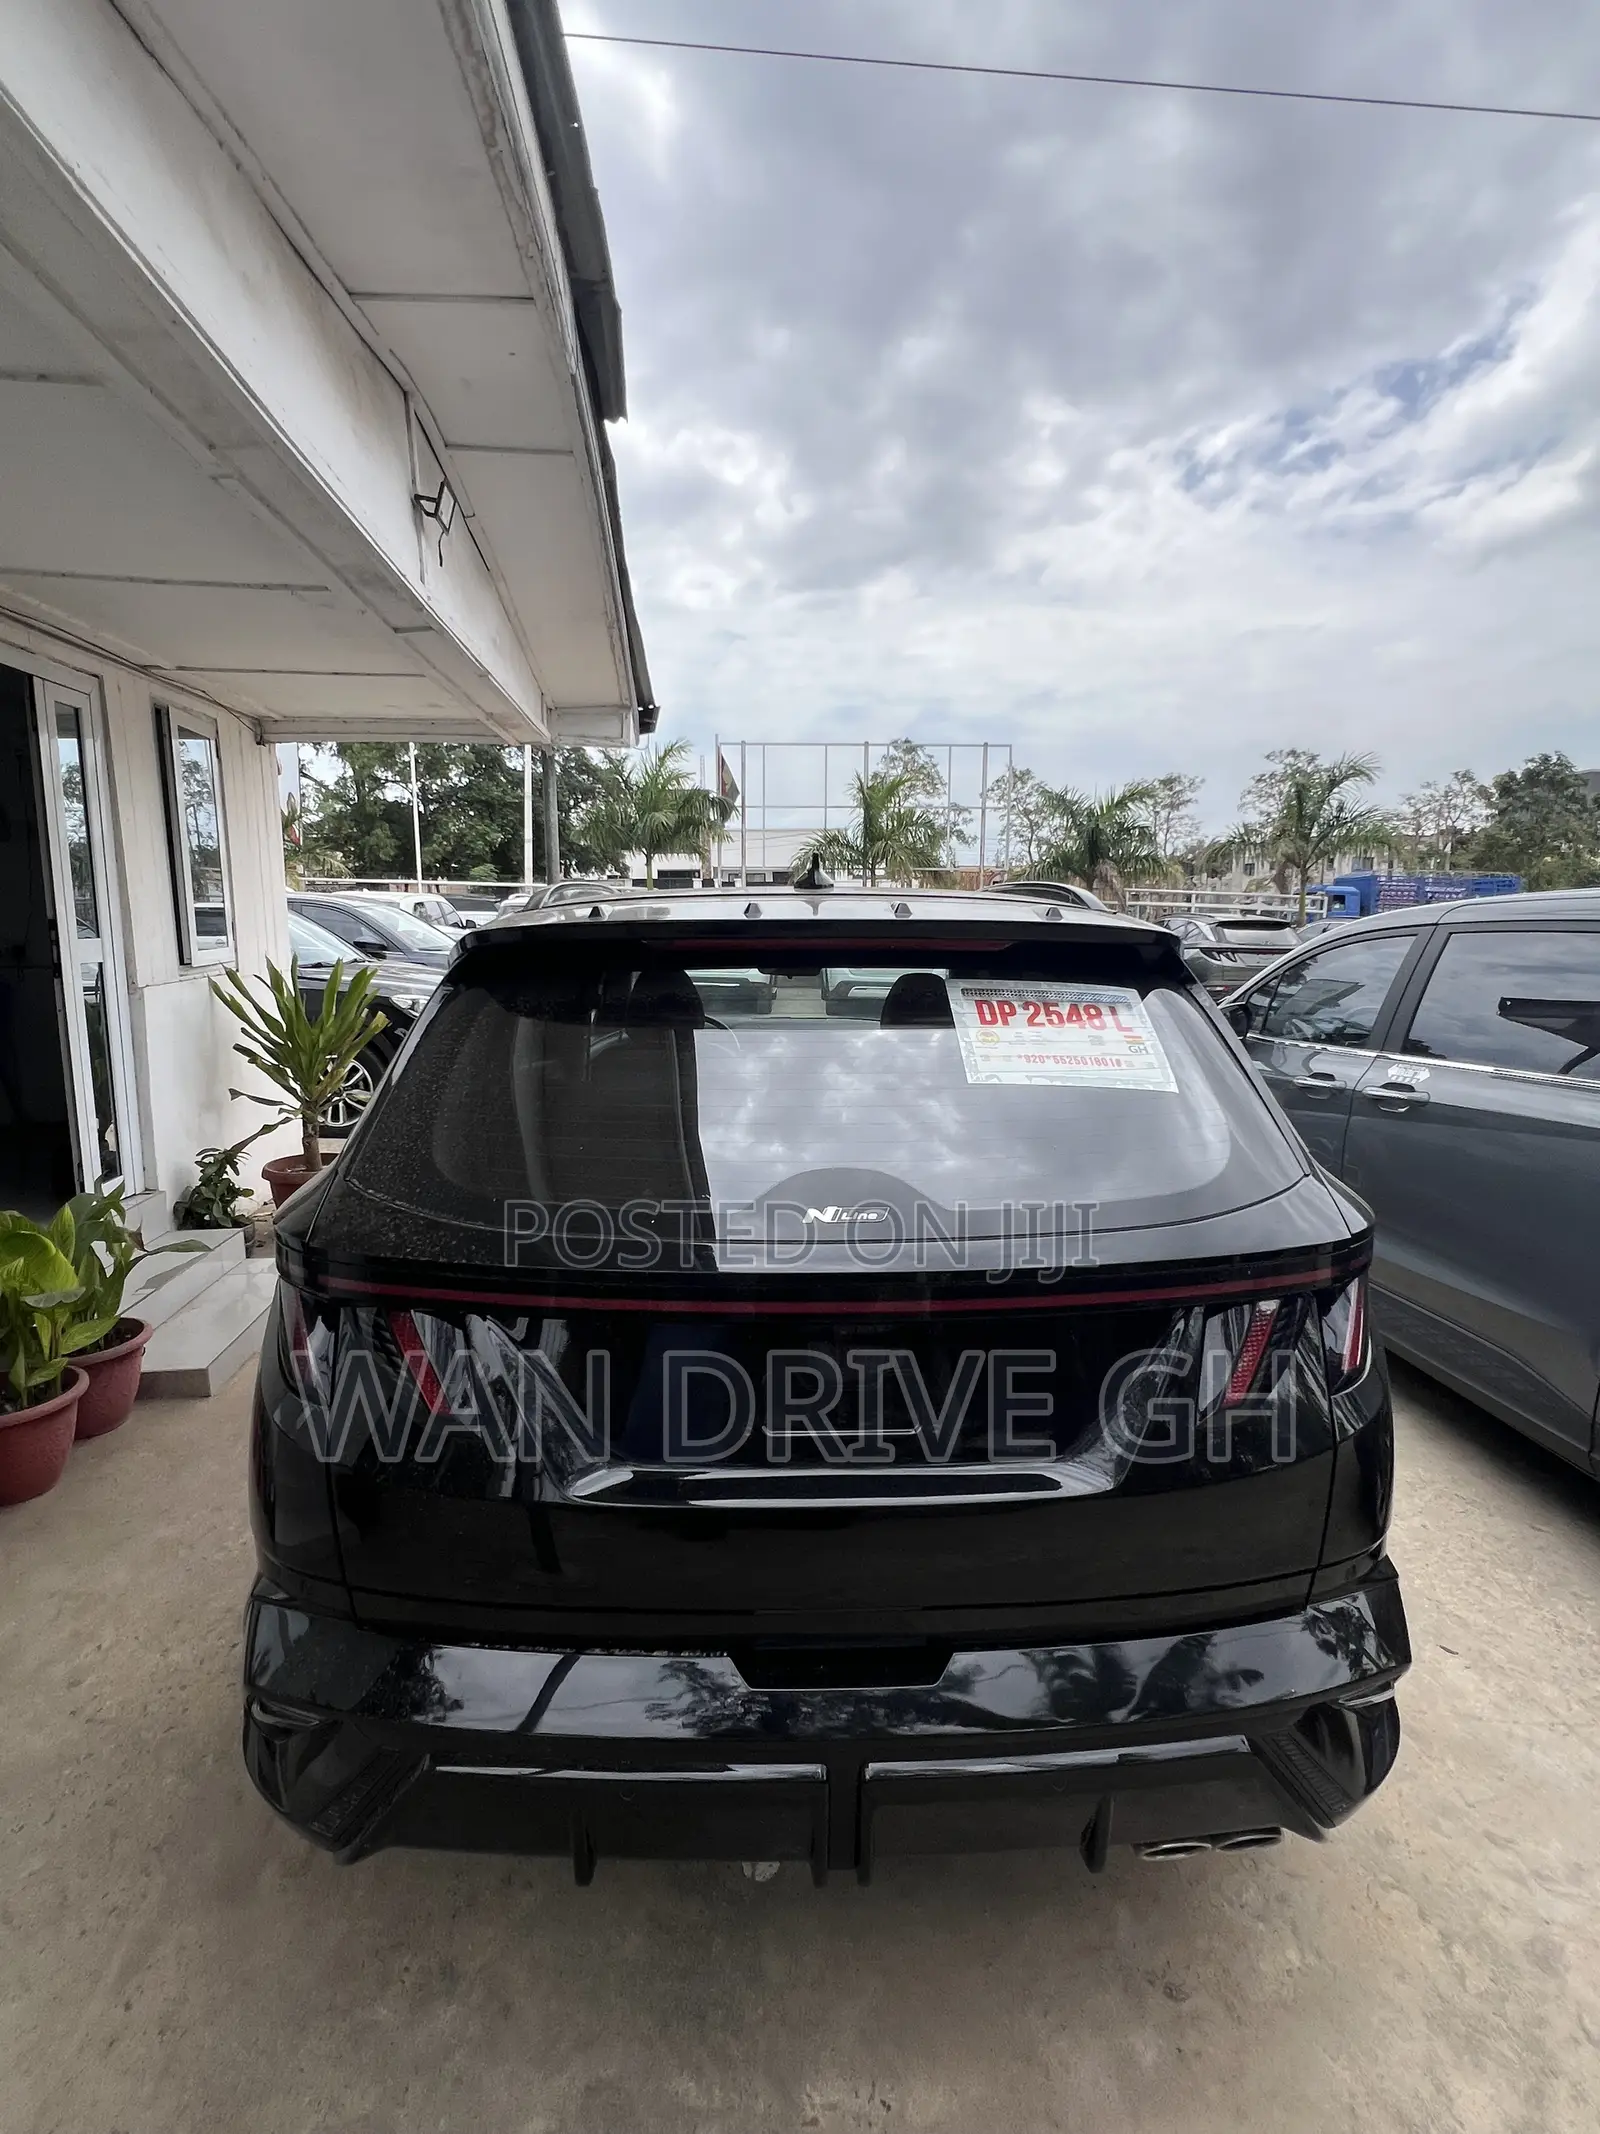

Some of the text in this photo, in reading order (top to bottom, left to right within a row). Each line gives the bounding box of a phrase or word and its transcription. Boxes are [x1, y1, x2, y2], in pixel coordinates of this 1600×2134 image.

[974, 999, 1133, 1033] DP 2548 L
[1128, 1044, 1149, 1056] GH
